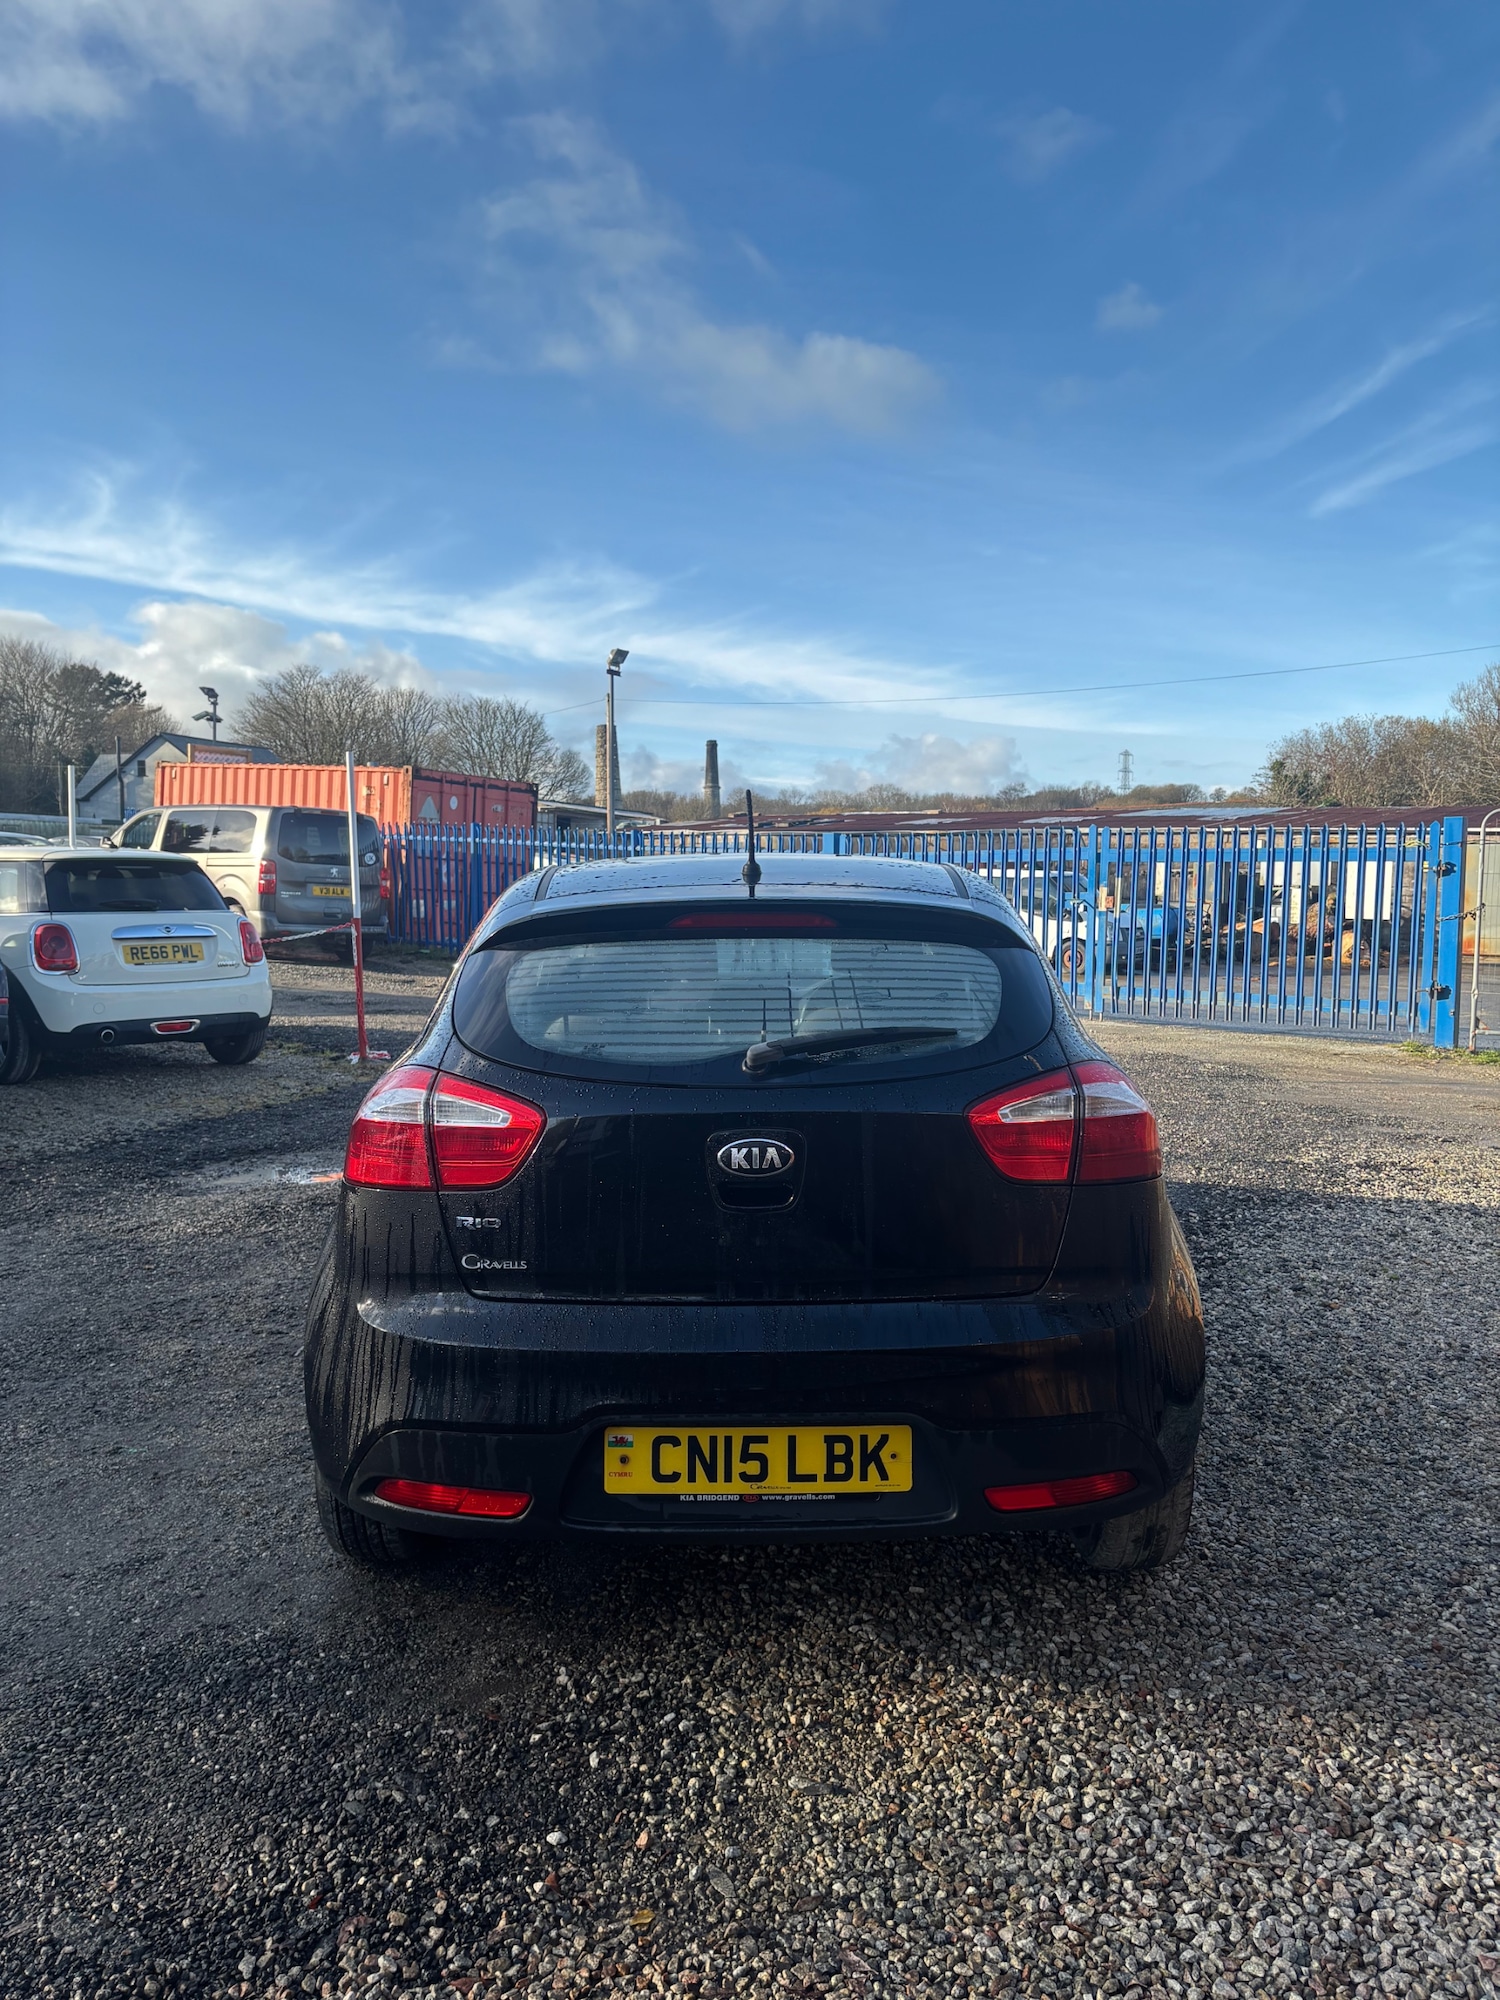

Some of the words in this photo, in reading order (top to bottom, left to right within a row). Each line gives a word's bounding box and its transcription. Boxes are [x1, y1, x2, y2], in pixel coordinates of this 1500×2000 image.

[130, 945, 169, 960] RE66
[171, 944, 199, 959] PWL
[730, 1147, 783, 1169] KIA
[456, 1216, 502, 1230] RIO
[461, 1253, 528, 1269] GRAVELLS
[651, 1435, 769, 1483] CN15
[787, 1434, 890, 1482] LBK
[761, 1494, 836, 1502] www.gravells.com
